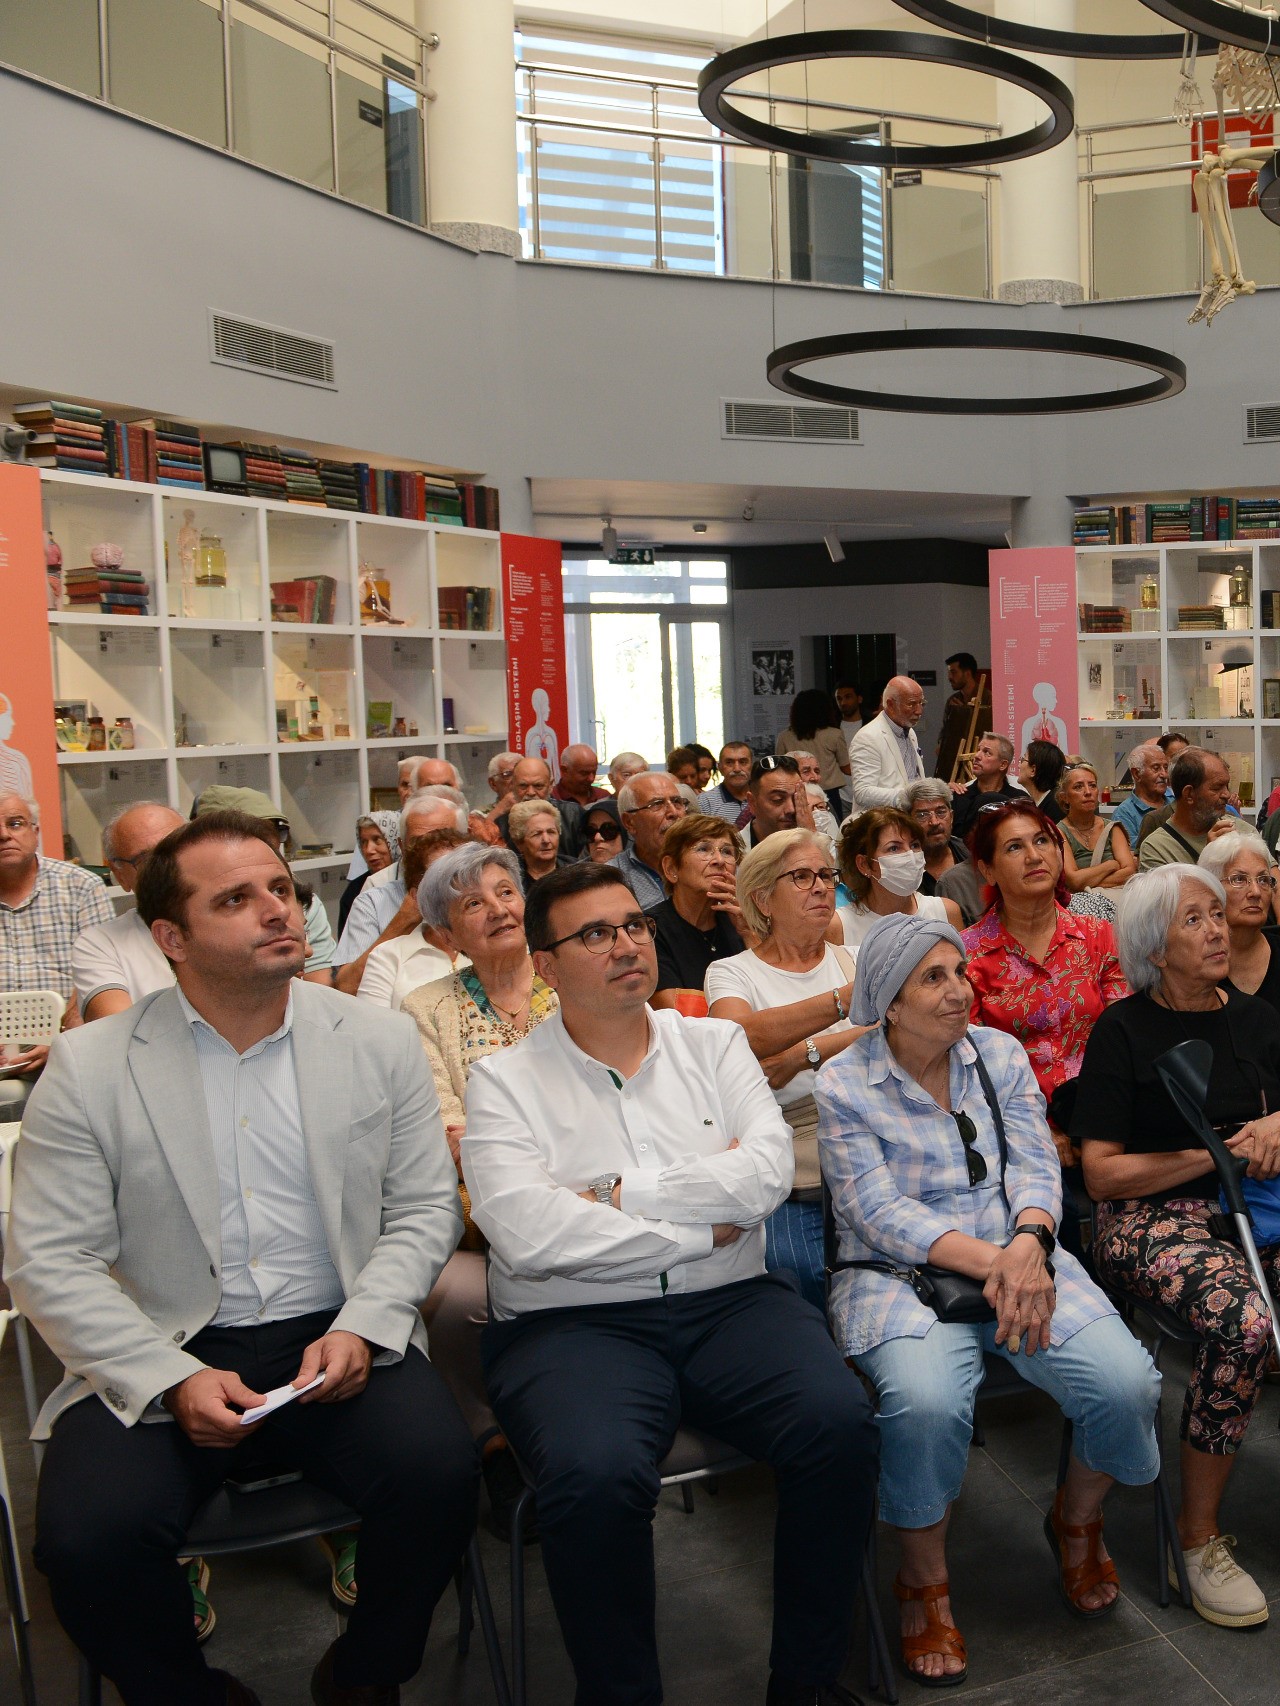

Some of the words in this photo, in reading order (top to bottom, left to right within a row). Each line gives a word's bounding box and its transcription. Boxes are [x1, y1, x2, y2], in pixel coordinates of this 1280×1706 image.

[511, 657, 519, 698] SİSTEMİ
[1006, 684, 1015, 719] SİSTEMİ
[514, 702, 522, 750] DOLAŞIM
